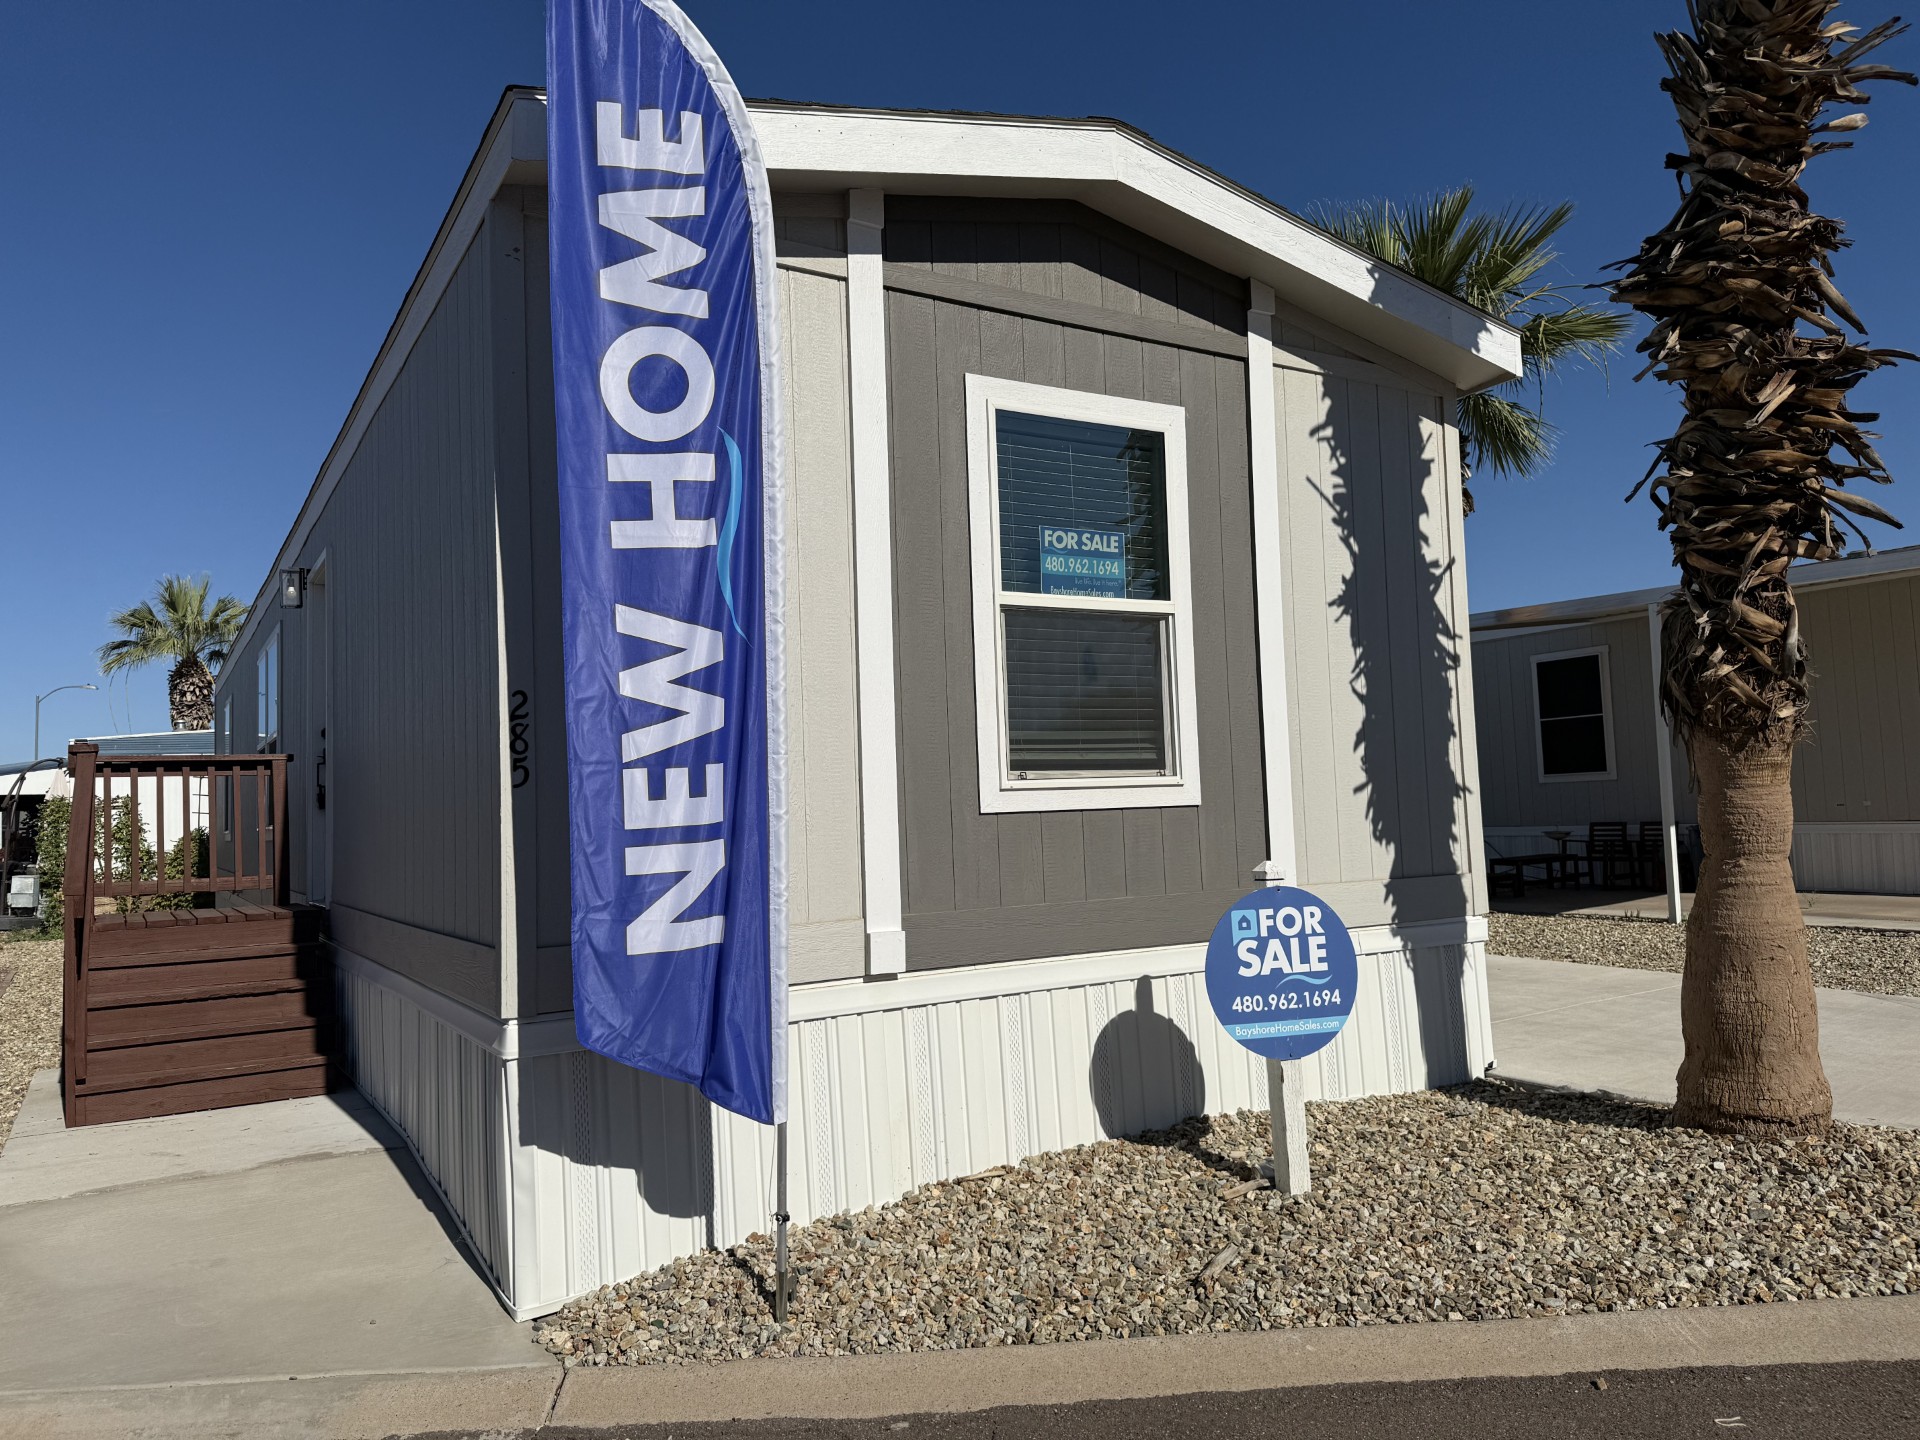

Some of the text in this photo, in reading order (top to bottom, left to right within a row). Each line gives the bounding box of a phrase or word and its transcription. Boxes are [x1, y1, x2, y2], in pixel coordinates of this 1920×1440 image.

[596, 101, 726, 956] NEW HOME
[1044, 530, 1119, 553] FOR SALE
[1045, 556, 1120, 576] 480.962.1694
[1258, 905, 1326, 937] FOR
[1237, 935, 1329, 978] SALE
[1231, 988, 1342, 1013] 480.962.1694
[1235, 1018, 1340, 1038] BayshoreHomeSales.com
